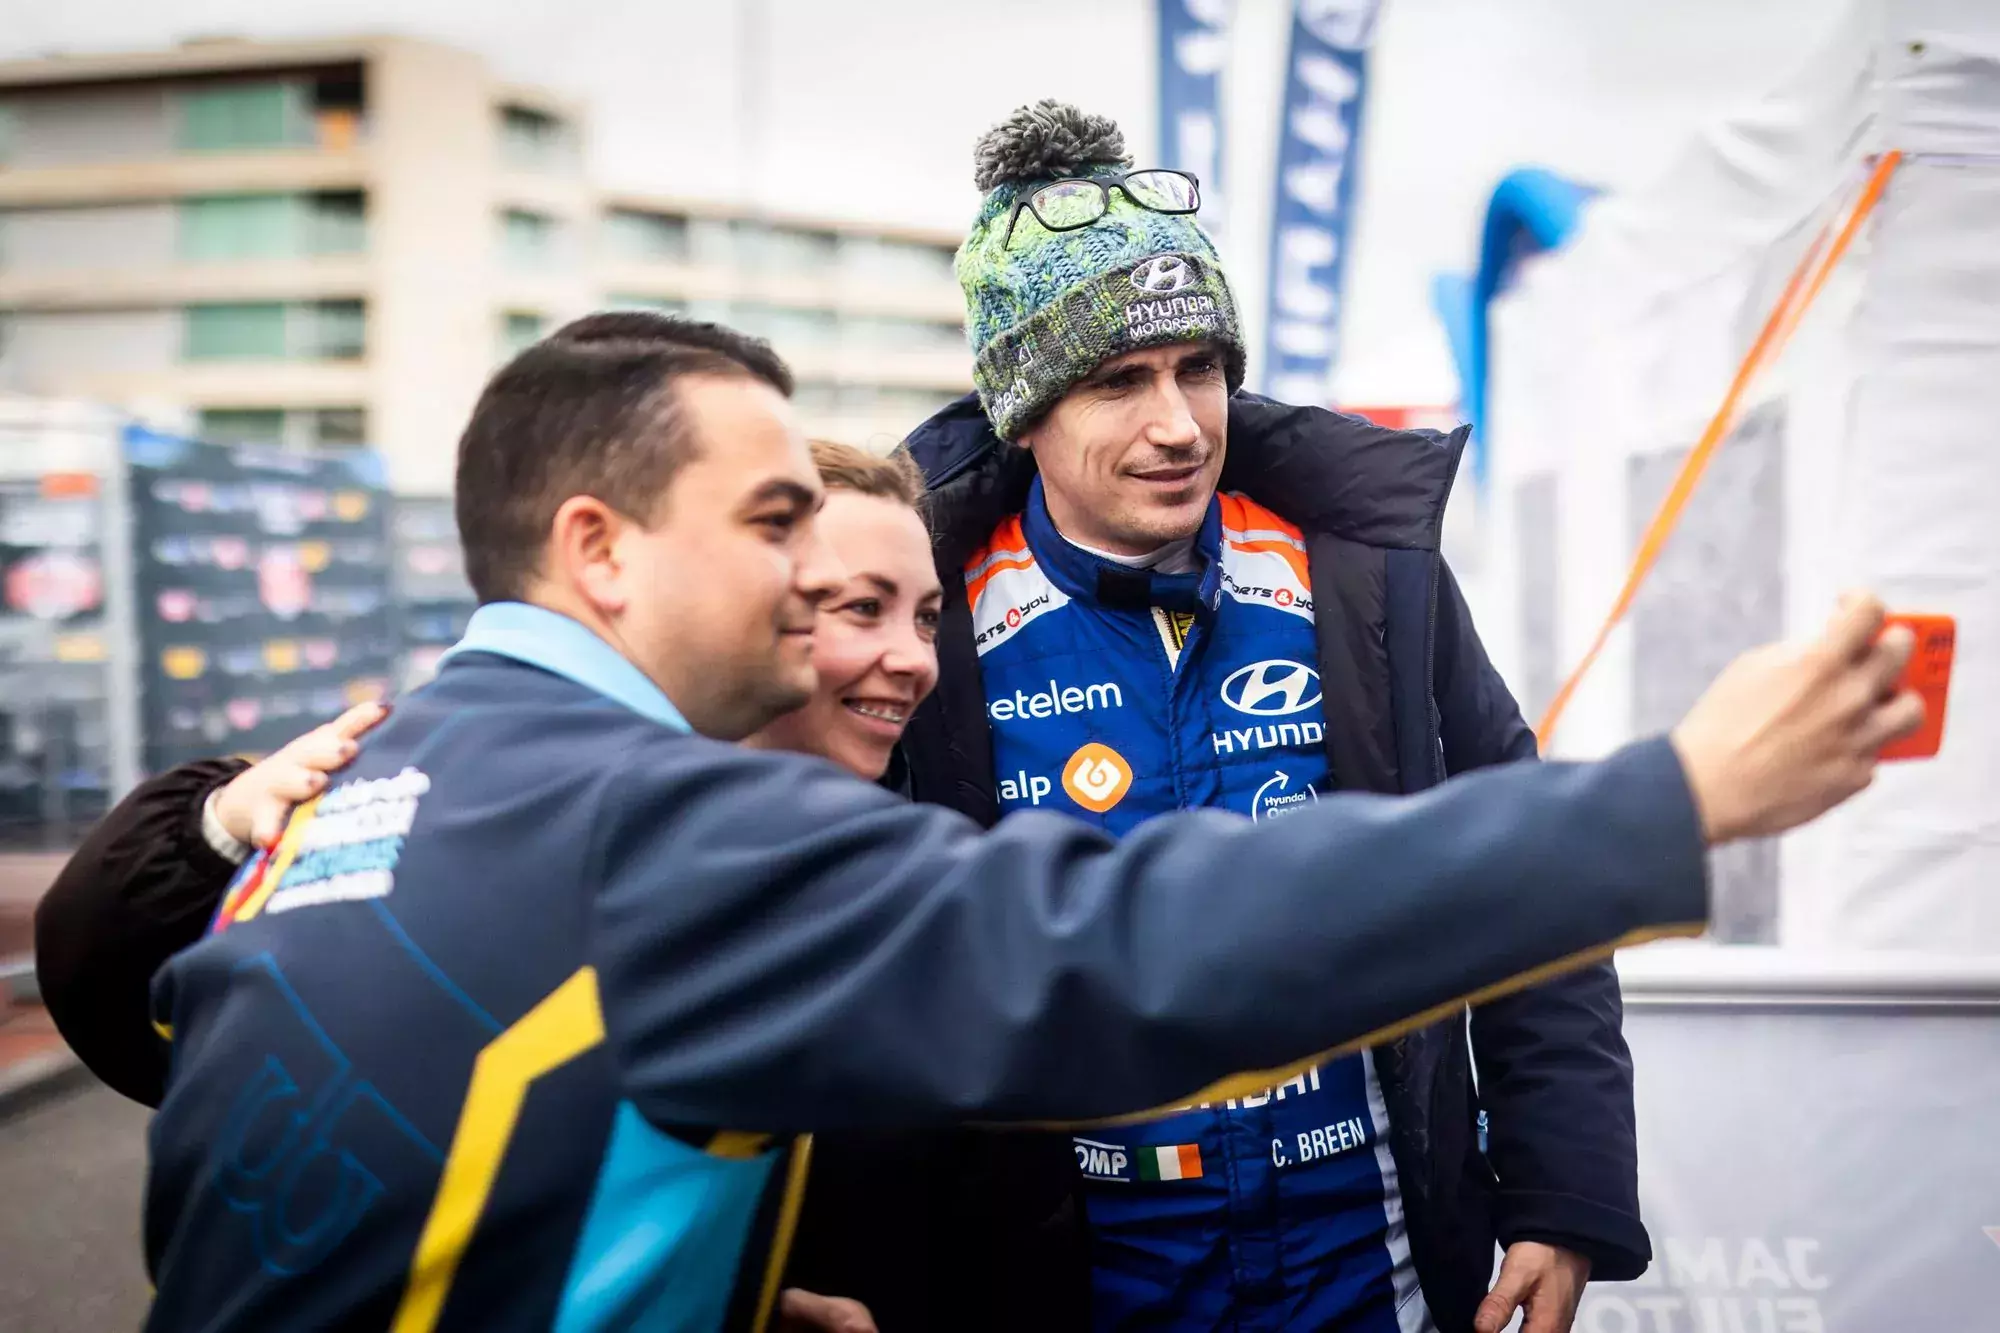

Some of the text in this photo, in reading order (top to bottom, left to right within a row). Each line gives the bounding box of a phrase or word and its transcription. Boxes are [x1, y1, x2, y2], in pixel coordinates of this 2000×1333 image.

[1126, 295, 1215, 324] HYUNDAI
[1129, 313, 1218, 338] MOTORSPORT
[983, 679, 1123, 721] etelem
[1212, 721, 1326, 755] HYUND
[996, 770, 1051, 806] alp
[1264, 791, 1307, 807] Hyundai
[1271, 1116, 1366, 1169] C. BREEN
[1074, 1146, 1128, 1175] OMP
